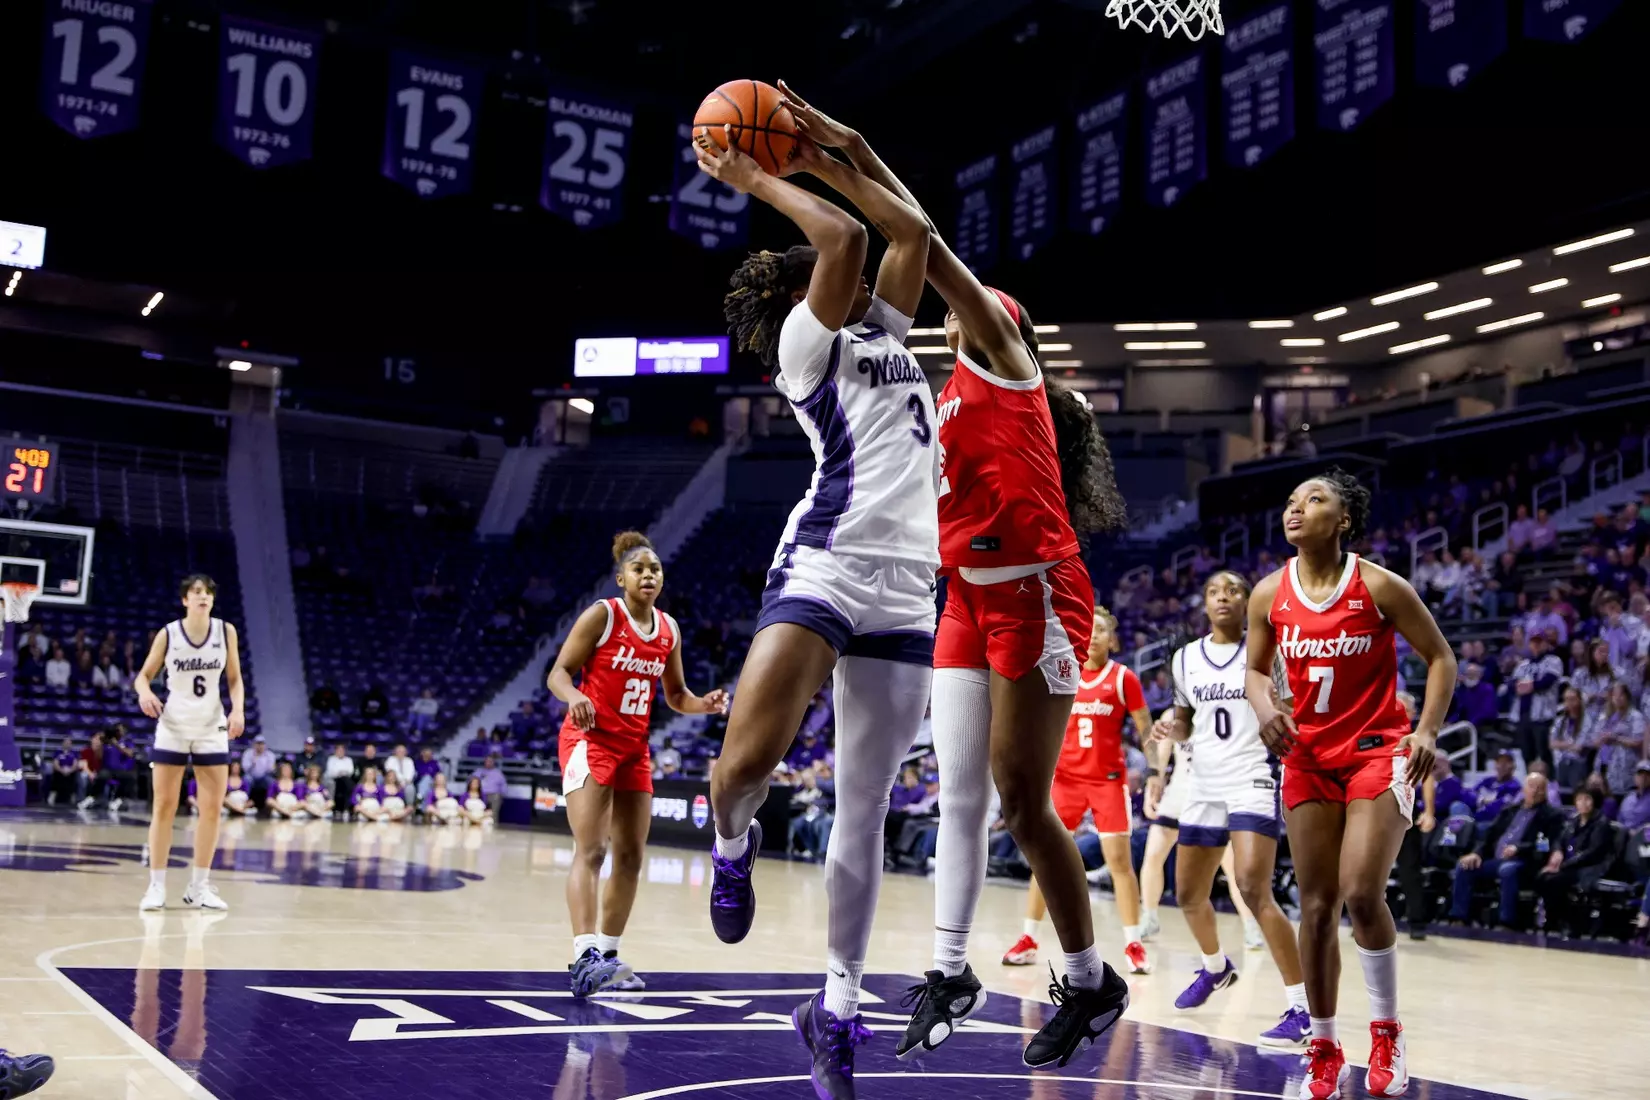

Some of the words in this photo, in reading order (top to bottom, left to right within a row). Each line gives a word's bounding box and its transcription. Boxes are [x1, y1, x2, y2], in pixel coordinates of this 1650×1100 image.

[61, 0, 135, 23] KRUGER
[52, 18, 138, 96] 12
[228, 27, 313, 59] WILLIAMS
[226, 52, 308, 126] 10
[409, 65, 464, 91] EVANS
[396, 86, 471, 160] 12
[548, 96, 634, 128] BLACKMAN
[547, 119, 625, 190] 25
[10, 238, 23, 256] 2
[384, 357, 416, 383] 15
[857, 353, 927, 389] Wildc
[906, 393, 932, 448] 3
[5, 463, 44, 494] 21
[1281, 624, 1372, 659] Houston
[173, 658, 221, 672] Wildcats
[193, 675, 206, 698] 6
[620, 677, 651, 715] 22
[1193, 682, 1249, 703] Wildcat
[1308, 666, 1335, 714] 7
[1071, 698, 1115, 717] ouston
[1215, 707, 1233, 740] 0
[1078, 717, 1093, 748] 2
